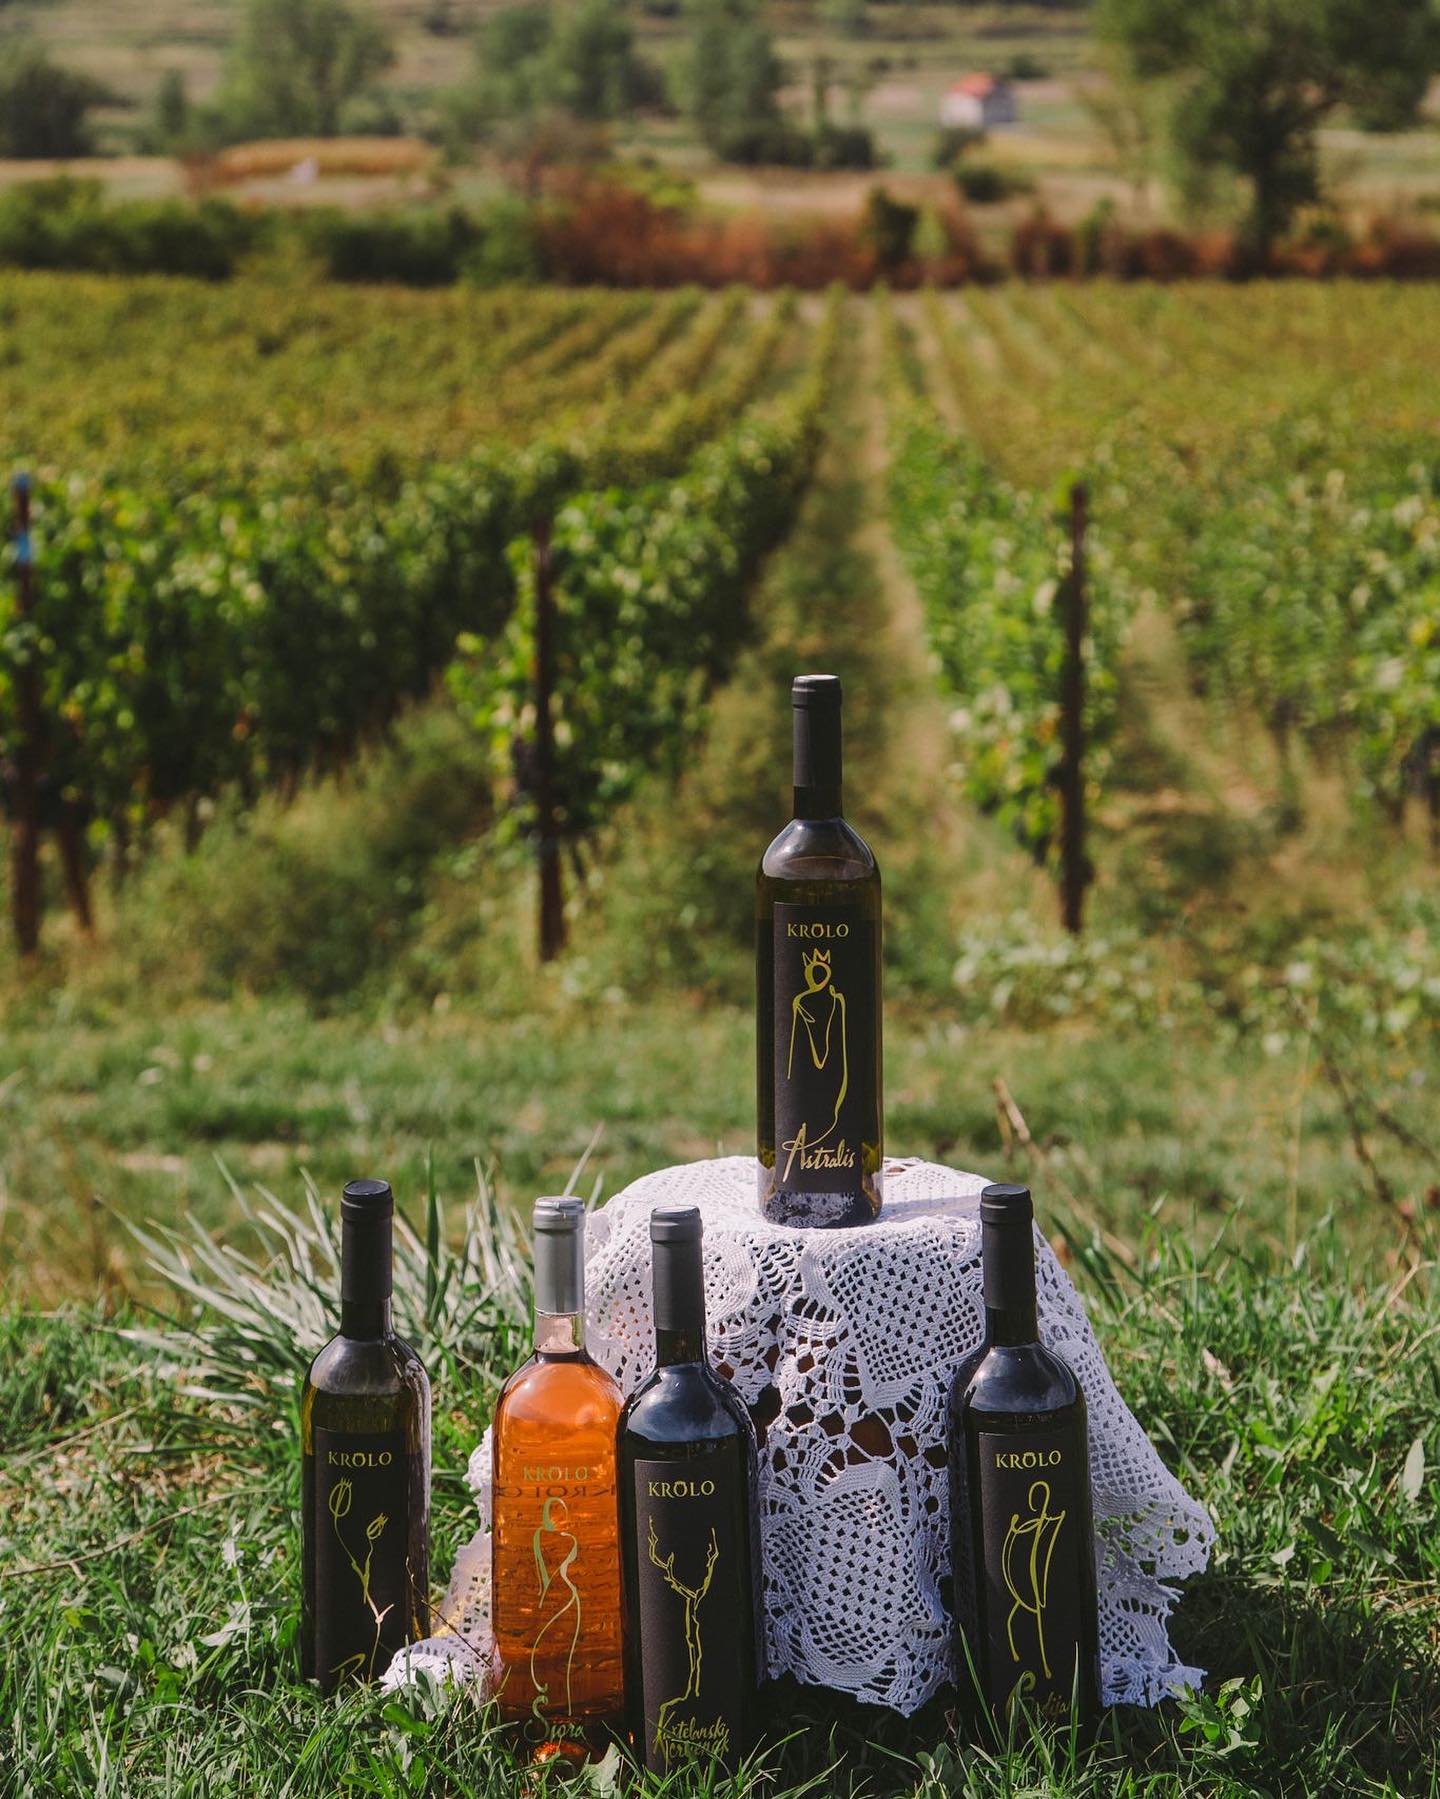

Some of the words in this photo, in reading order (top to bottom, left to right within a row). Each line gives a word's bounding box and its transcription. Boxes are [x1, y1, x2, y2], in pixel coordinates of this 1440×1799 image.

[787, 923, 849, 938] KROLO
[782, 1122, 855, 1183] Astralis
[328, 1451, 392, 1468] KROLO
[995, 1450, 1062, 1470] KROLO
[523, 1466, 588, 1481] KROLO
[648, 1480, 715, 1498] KROLO
